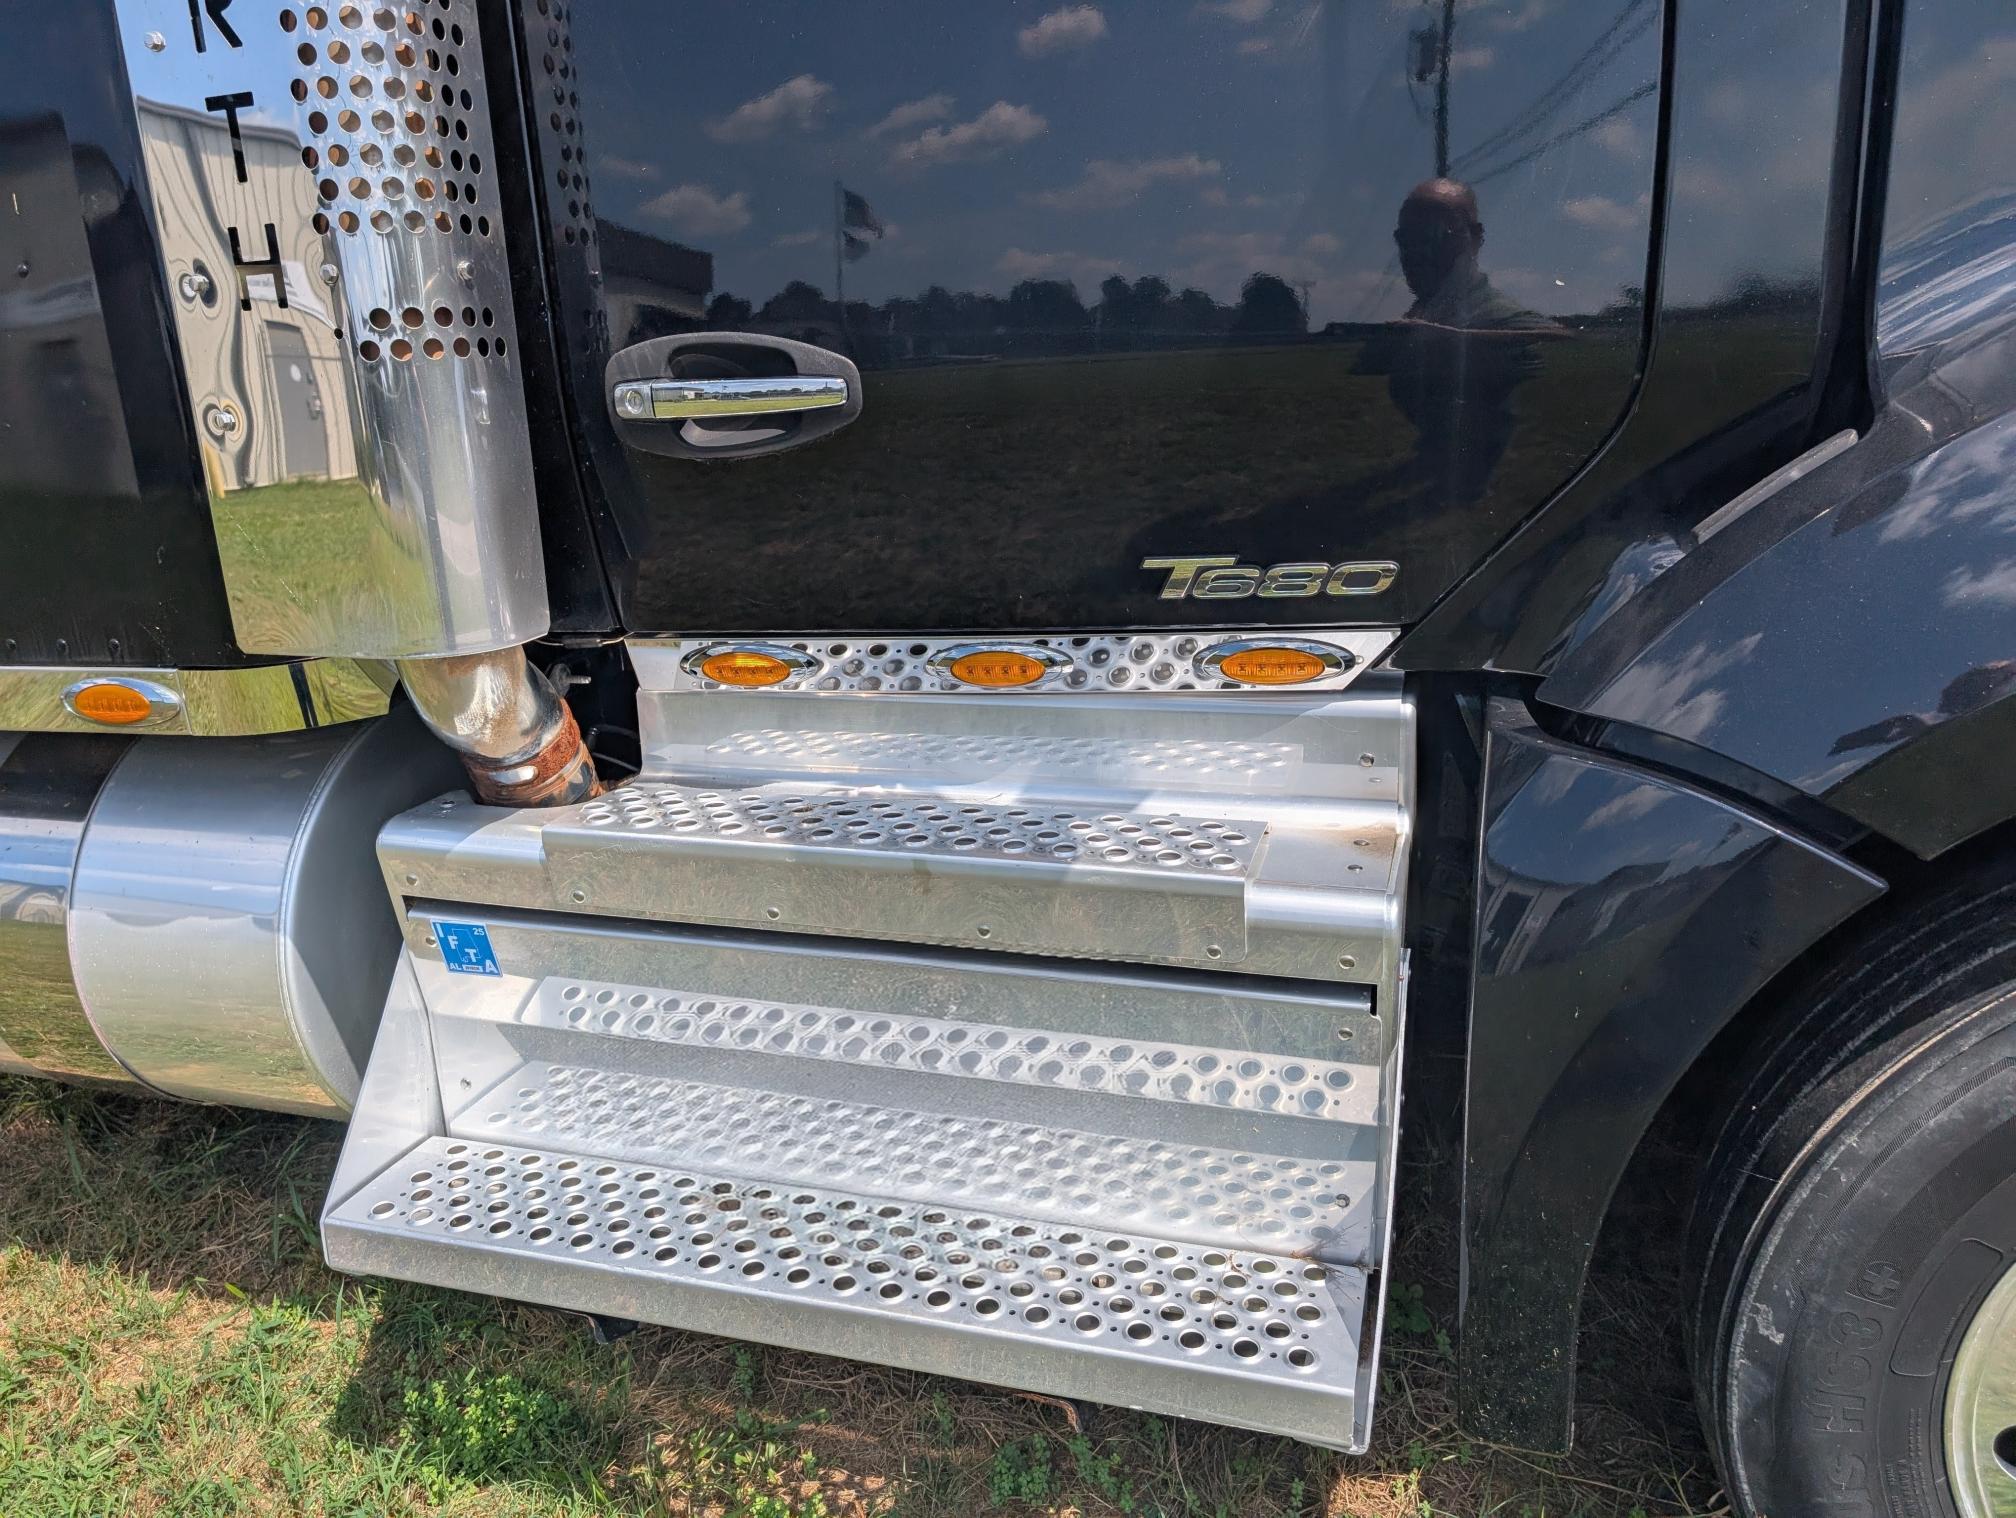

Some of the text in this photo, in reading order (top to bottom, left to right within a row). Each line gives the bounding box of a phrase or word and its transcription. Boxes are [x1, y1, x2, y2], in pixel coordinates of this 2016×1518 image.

[1142, 555, 1400, 600] T680
[472, 927, 485, 936] 25
[449, 962, 462, 971] AL
